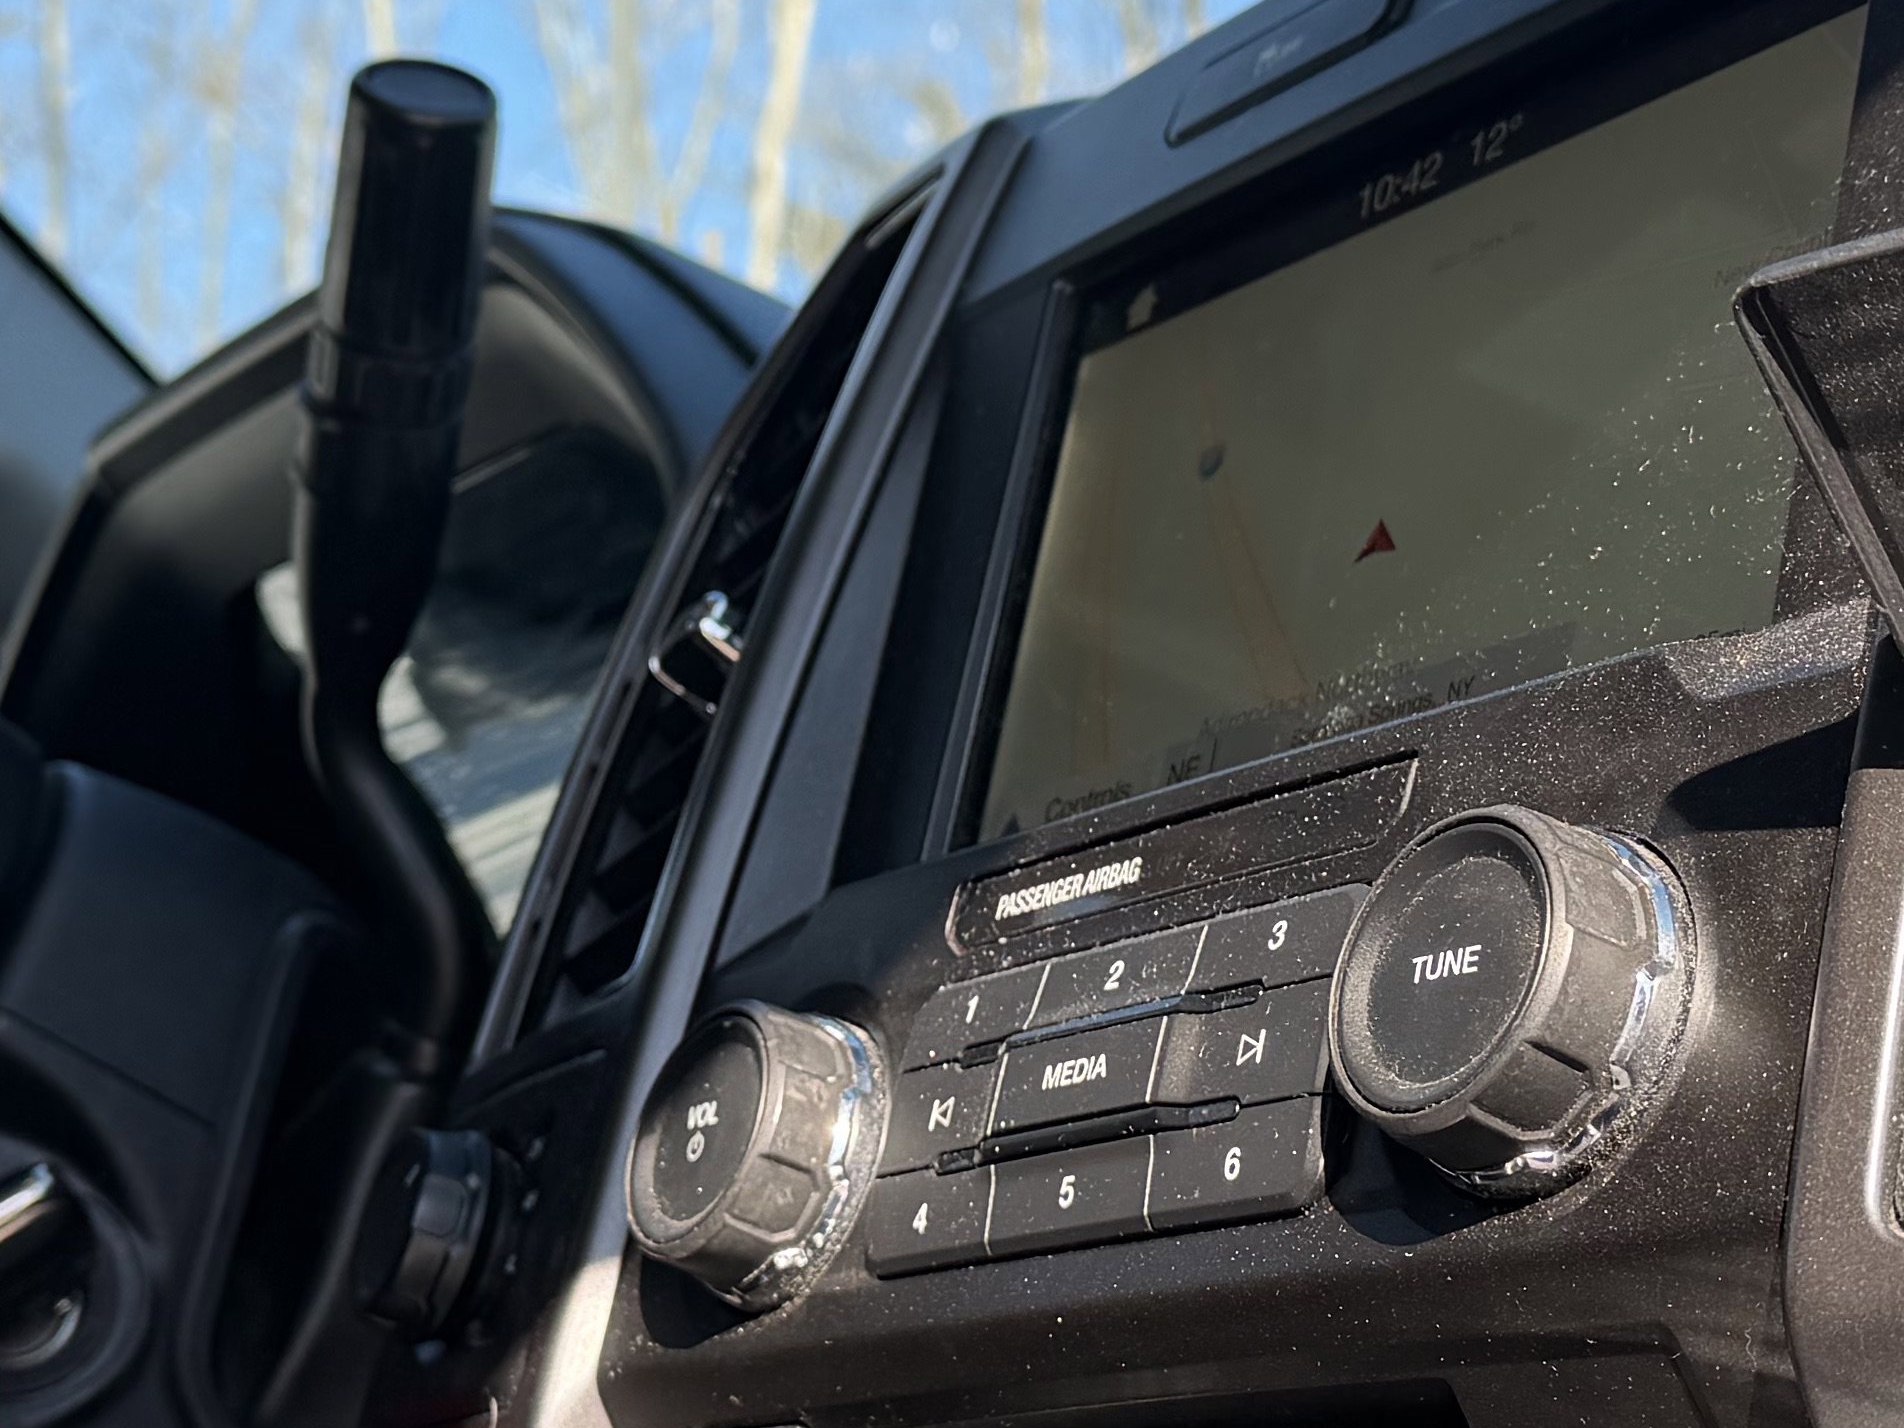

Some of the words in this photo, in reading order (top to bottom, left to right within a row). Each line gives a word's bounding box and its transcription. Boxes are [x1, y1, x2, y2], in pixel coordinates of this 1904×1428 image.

[1359, 150, 1444, 219] 10:42
[1447, 675, 1475, 703] NY
[995, 872, 1084, 920] PASSENGER
[1082, 856, 1142, 895] AIRBAG
[1268, 920, 1288, 950] 3
[1103, 960, 1125, 990] 2
[1412, 944, 1482, 984] TUNE
[965, 995, 979, 1024] 1
[1041, 1053, 1107, 1090] MEDIA
[687, 1100, 719, 1130] VOL
[1224, 1147, 1241, 1180] 6
[1058, 1175, 1075, 1208] 5
[912, 1202, 928, 1234] 4
